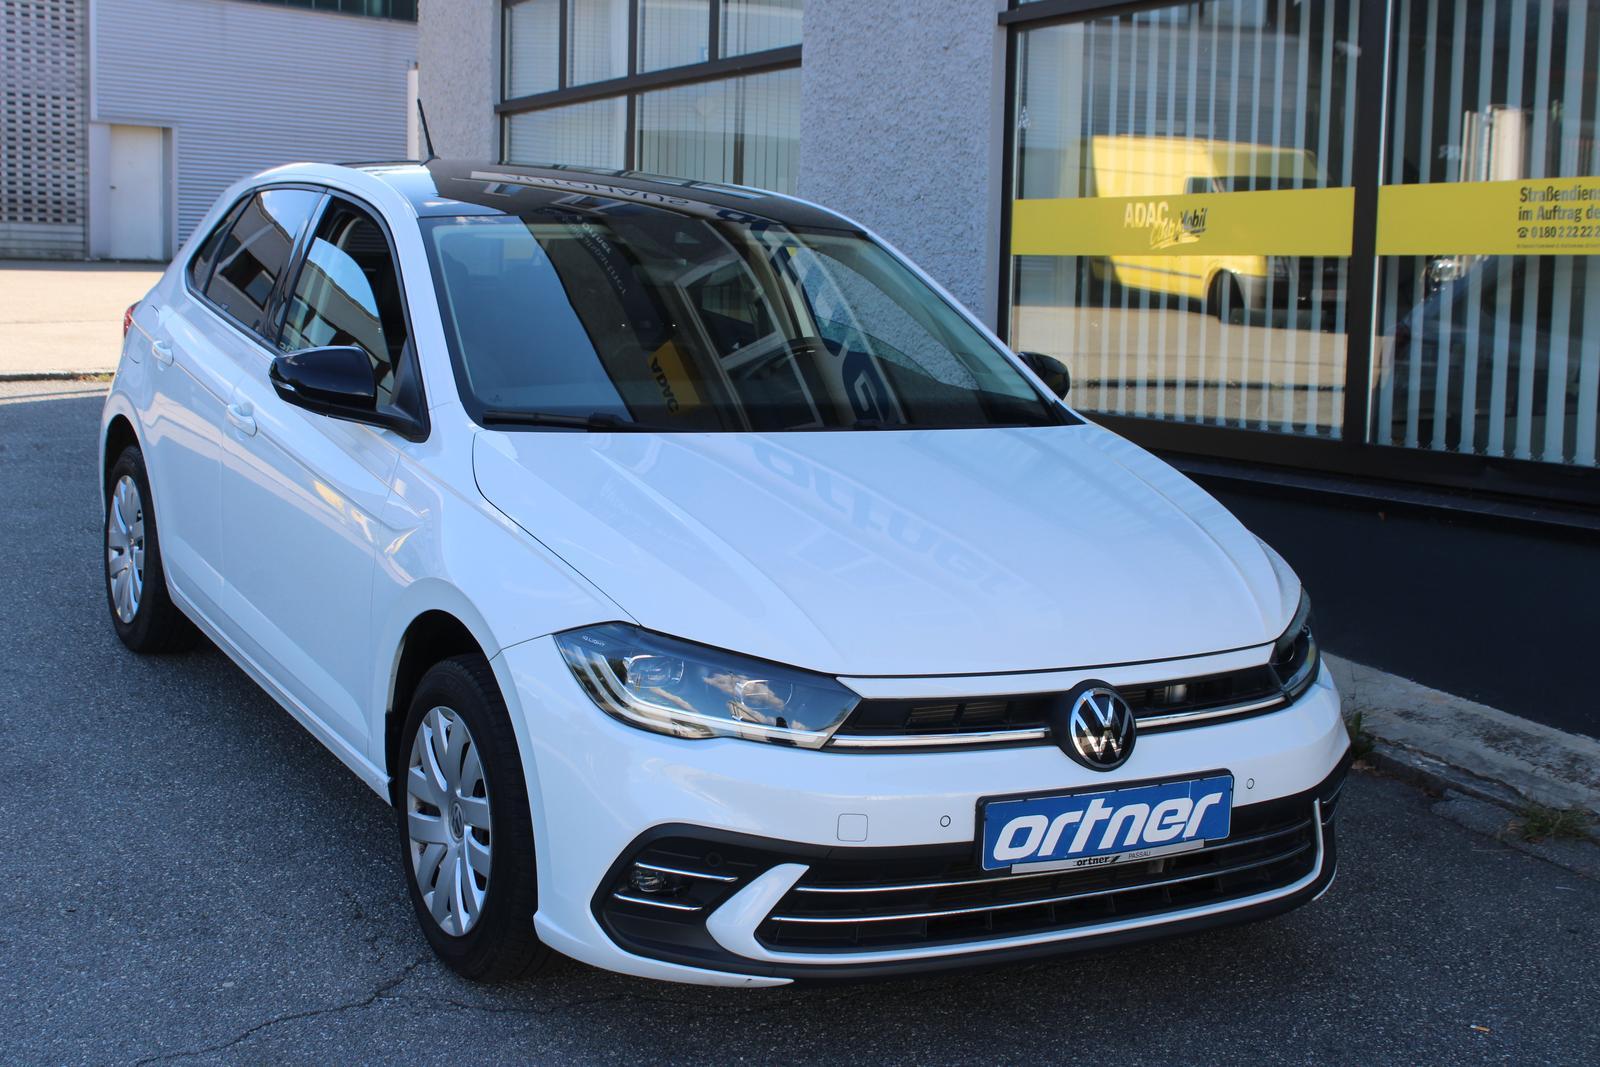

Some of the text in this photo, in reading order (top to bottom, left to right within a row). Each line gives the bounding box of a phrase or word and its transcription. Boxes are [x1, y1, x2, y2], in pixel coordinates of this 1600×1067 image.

[1124, 201, 1168, 229] ADAC
[1518, 206, 1533, 221] im
[1537, 205, 1582, 223] Auftrag
[993, 792, 1223, 861] ortner
[1076, 850, 1152, 867] ortner PASSAU
